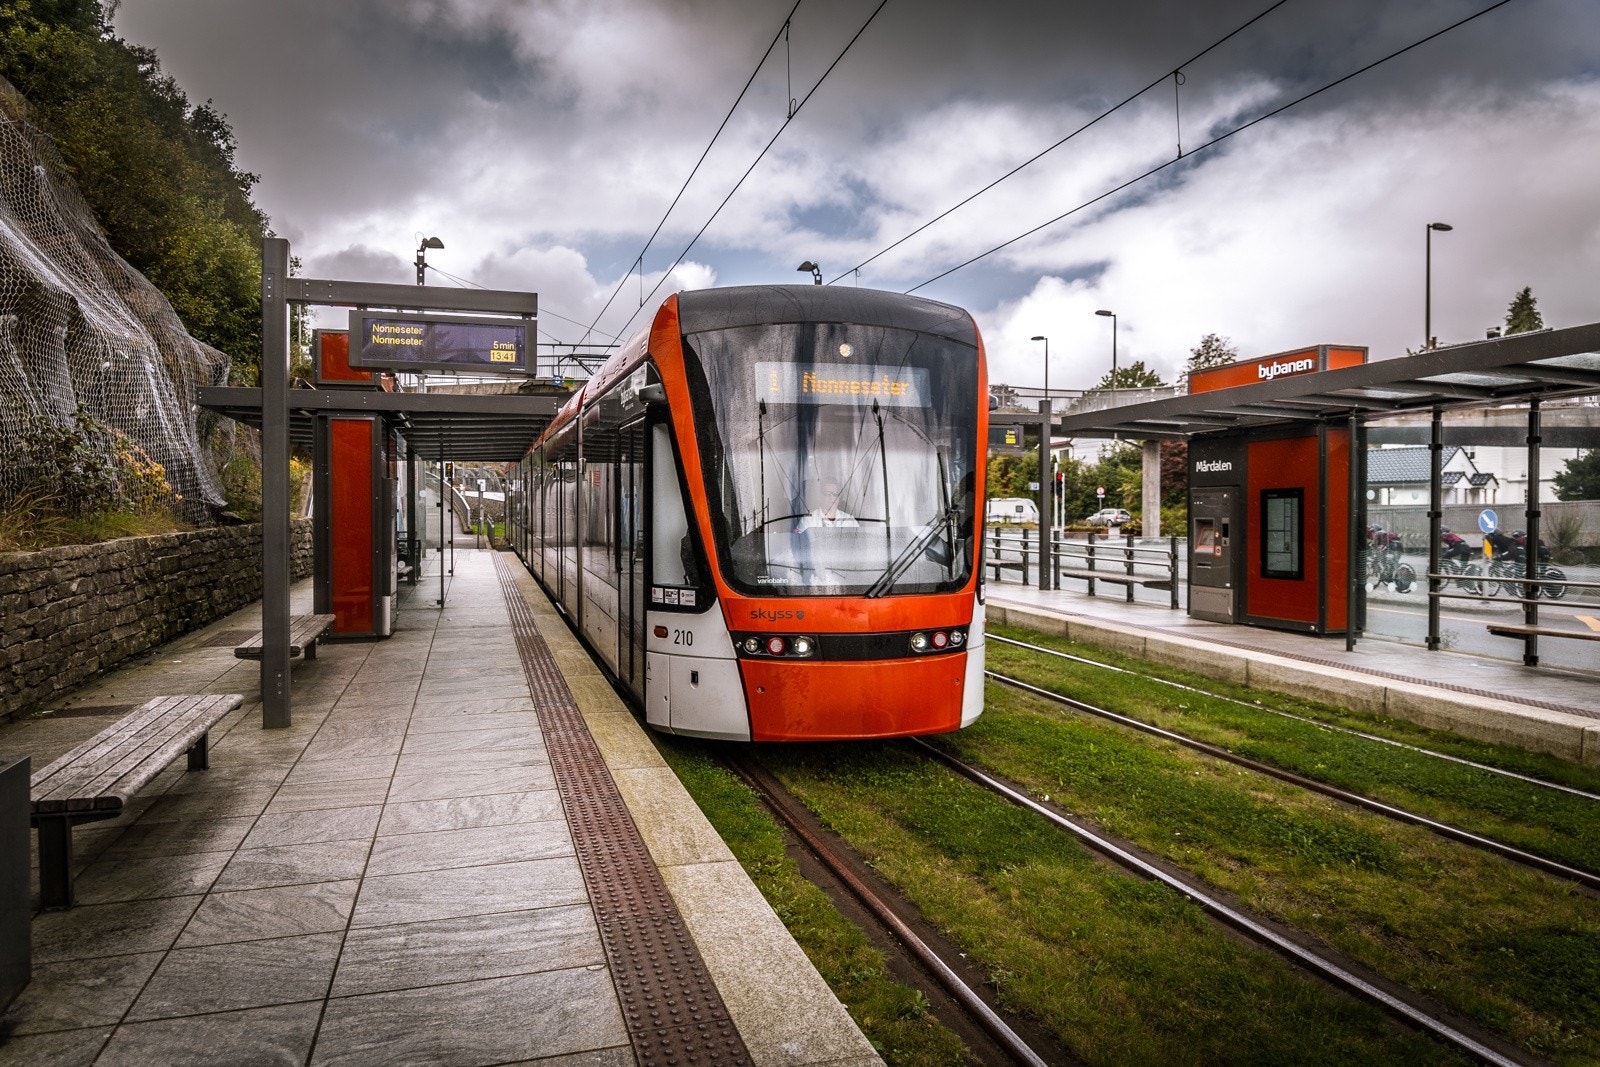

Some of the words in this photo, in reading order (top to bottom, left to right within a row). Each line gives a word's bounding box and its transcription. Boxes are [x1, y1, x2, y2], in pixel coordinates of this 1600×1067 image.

[372, 323, 423, 335] Nonneseter
[372, 334, 423, 346] Nonneseter
[491, 351, 515, 361] 13:41
[1258, 358, 1312, 379] bybanen
[802, 371, 910, 396] Nonneseter
[1195, 459, 1232, 472] Mårdalen
[750, 607, 794, 622] skyss
[674, 629, 693, 647] 210
